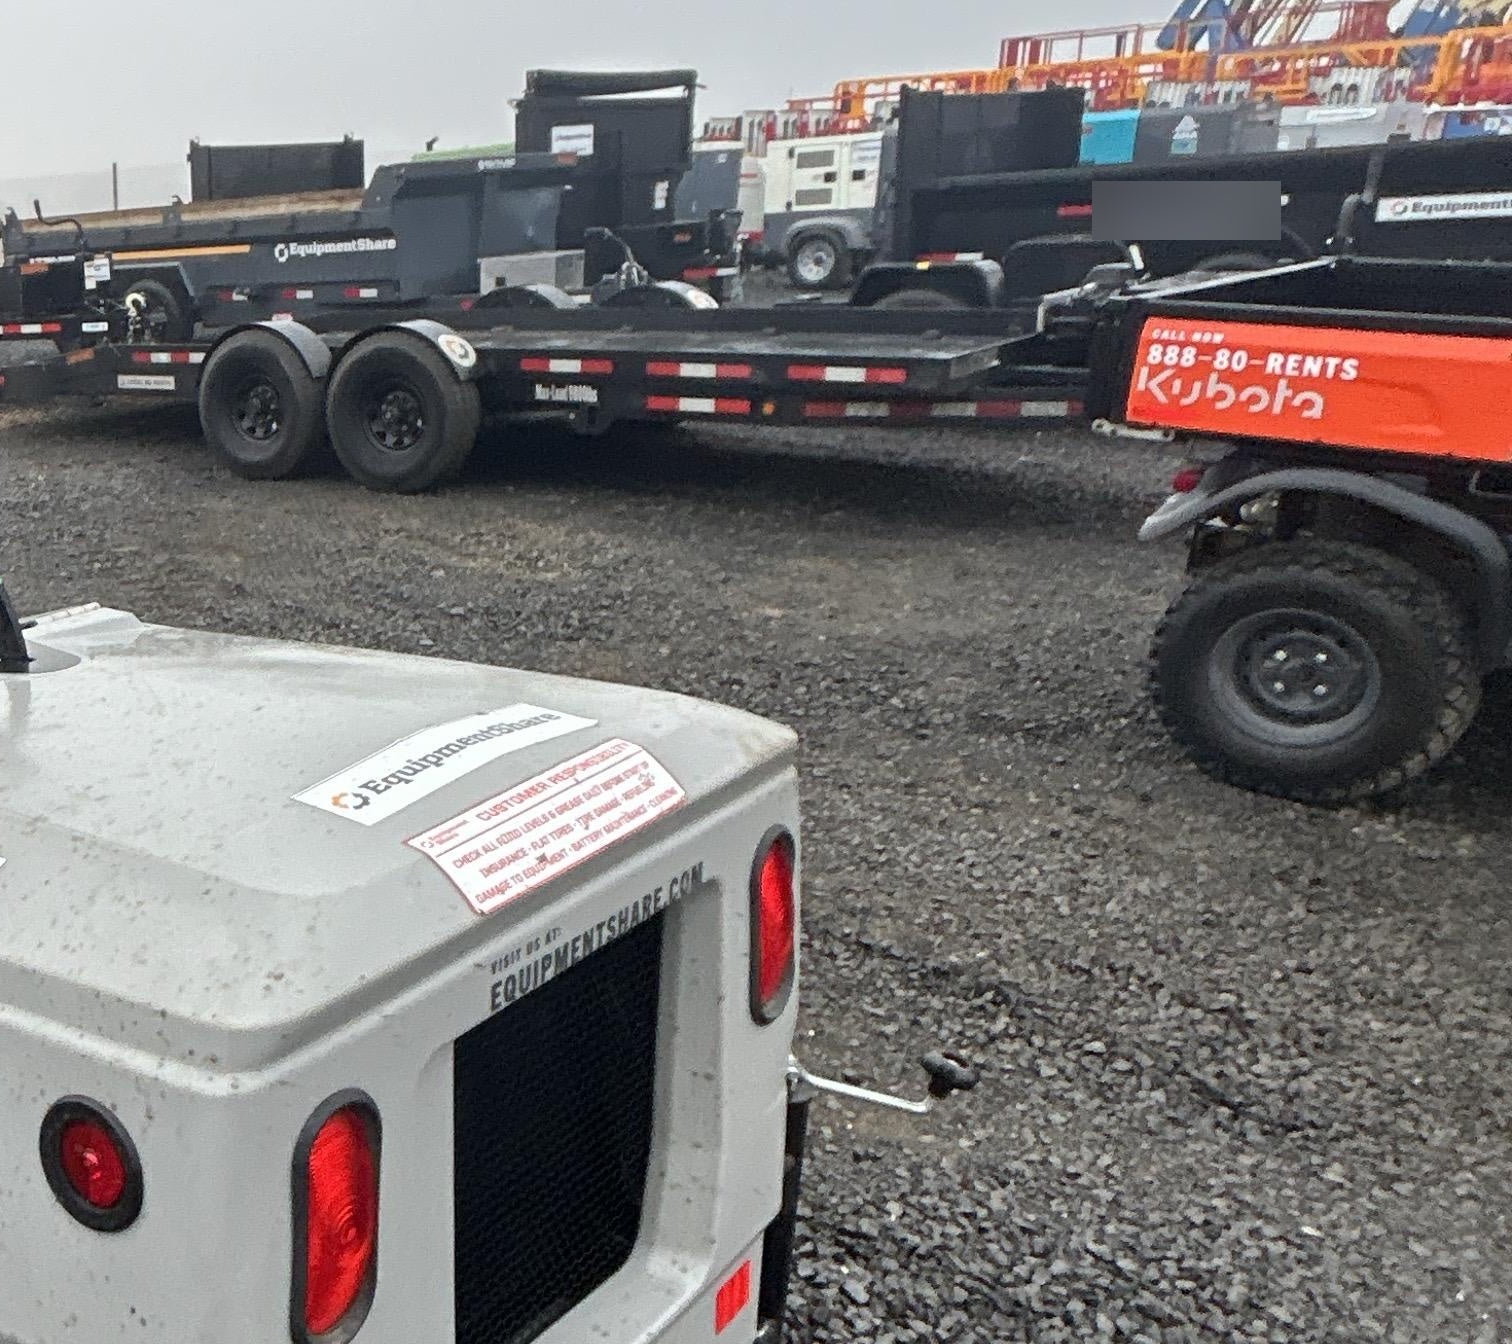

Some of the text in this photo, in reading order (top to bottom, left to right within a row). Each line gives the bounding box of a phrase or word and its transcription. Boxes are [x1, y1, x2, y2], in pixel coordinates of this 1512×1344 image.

[289, 238, 397, 256] EquipmentShare
[1151, 328, 1186, 341] CALL
[1147, 343, 1360, 380] 888-80-RENTS
[1136, 366, 1325, 420] Kubota
[360, 711, 562, 797] EquipmentShare
[476, 782, 552, 822] CUSTOMER
[452, 849, 483, 869] CHECK
[481, 842, 498, 856] ALL
[490, 861, 705, 1012] EQUIPMENTSHARE.COM
[491, 947, 521, 975] VISIT
